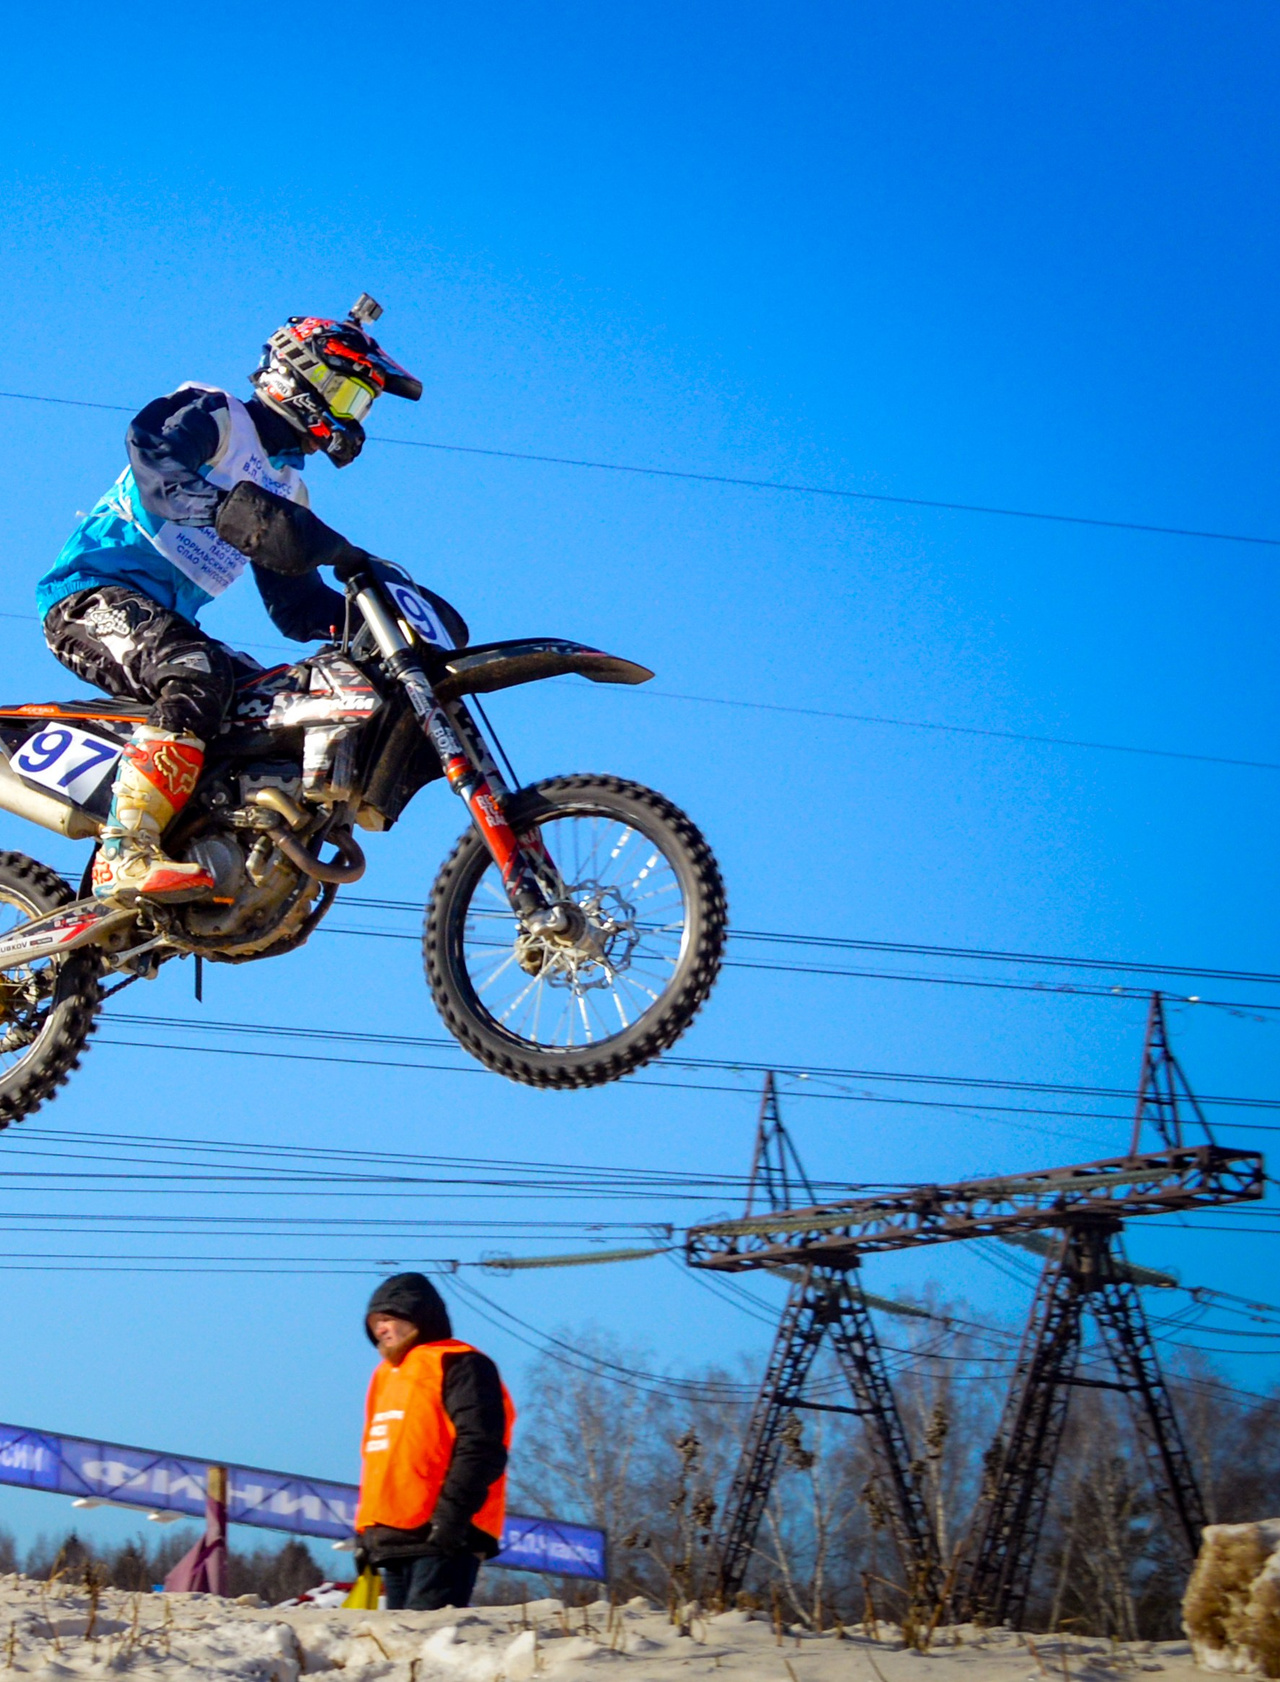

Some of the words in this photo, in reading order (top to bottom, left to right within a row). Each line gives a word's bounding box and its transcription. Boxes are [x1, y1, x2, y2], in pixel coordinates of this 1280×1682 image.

[175, 531, 228, 575] НОРИЛЬСКИЙ
[175, 543, 200, 565] СПАО
[18, 729, 118, 788] 97
